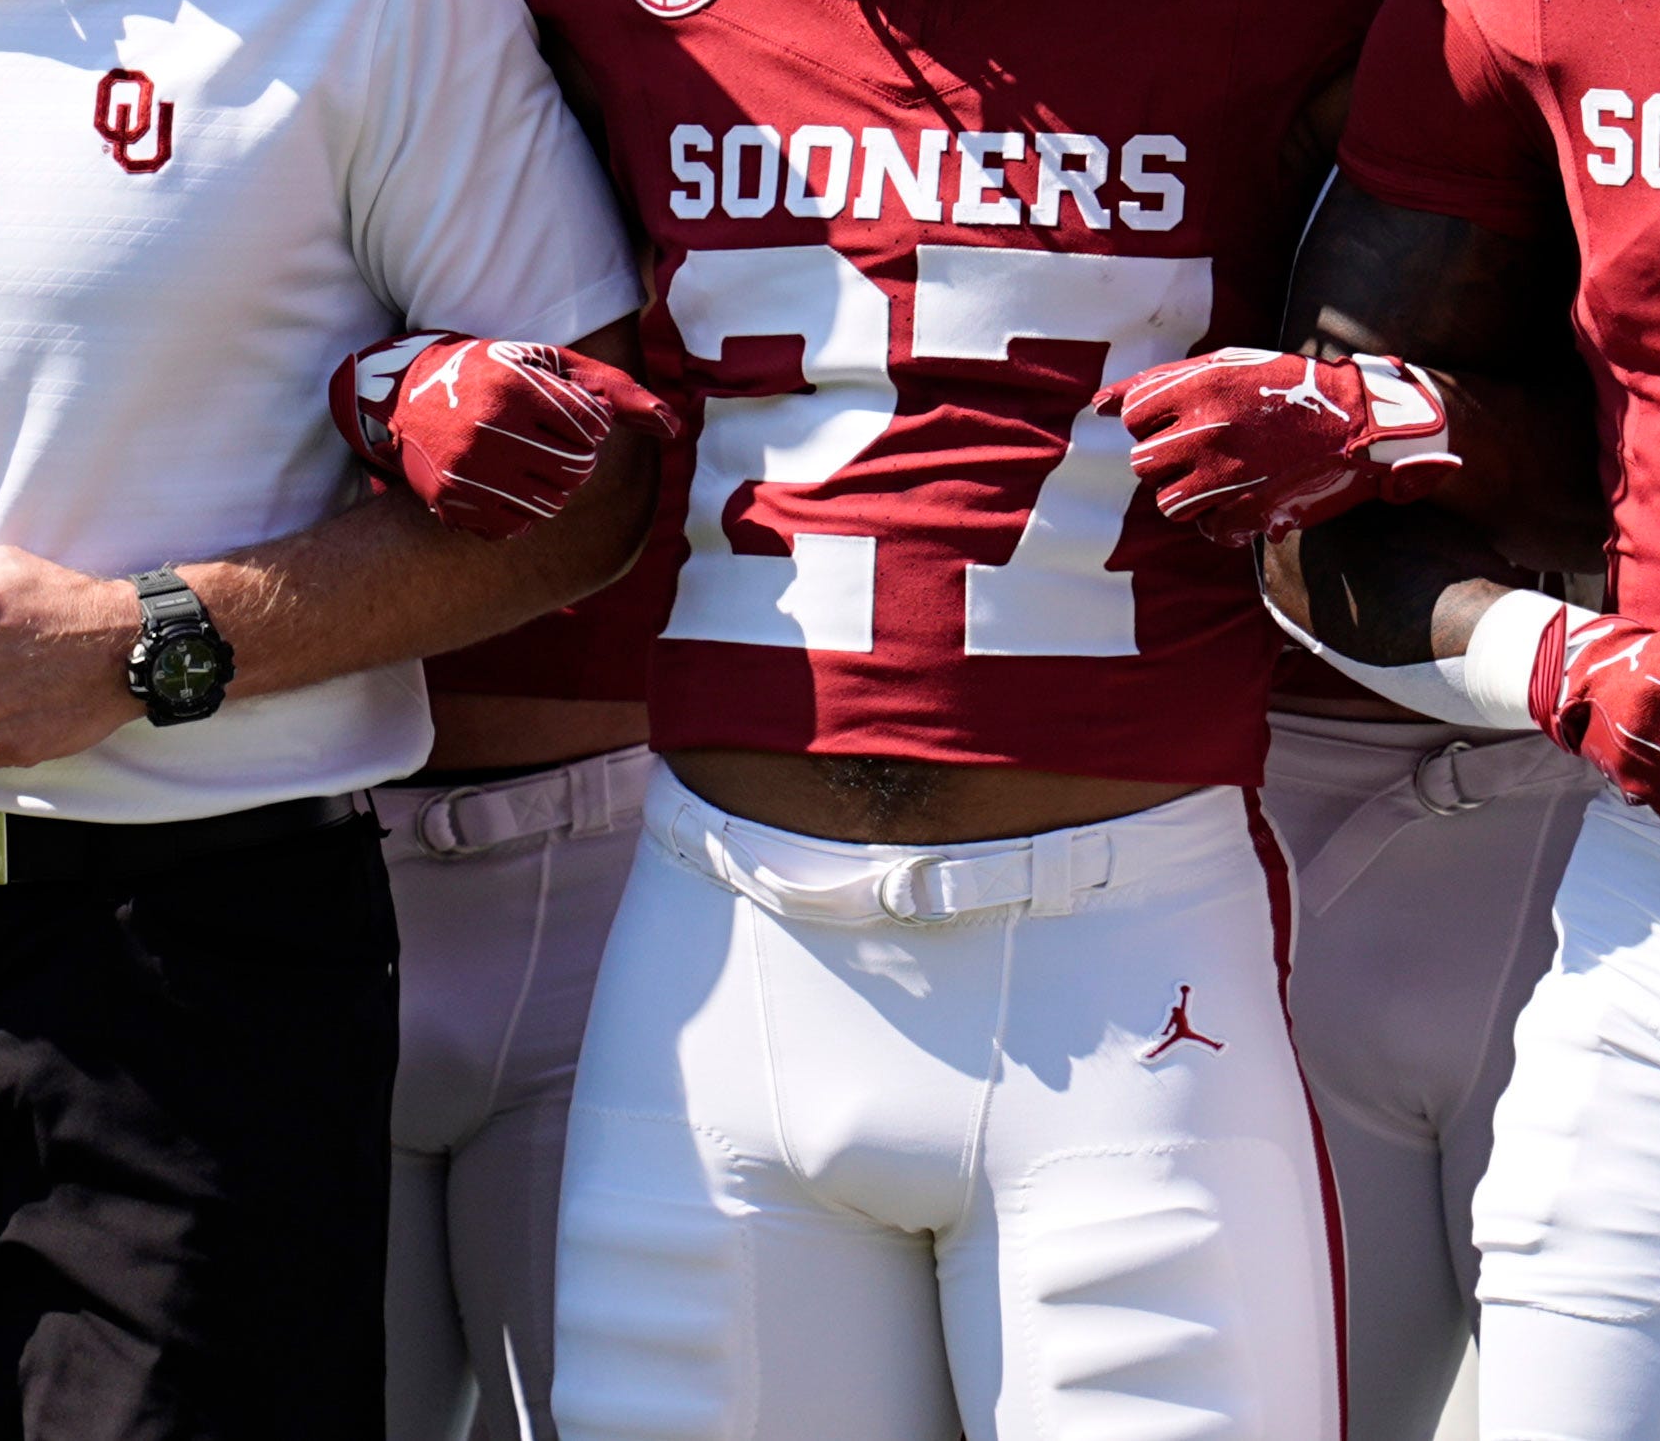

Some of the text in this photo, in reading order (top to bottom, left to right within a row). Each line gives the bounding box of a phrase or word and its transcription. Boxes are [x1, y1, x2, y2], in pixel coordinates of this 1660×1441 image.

[94, 68, 174, 174] OU
[670, 124, 1187, 232] SOONERS
[659, 245, 1214, 657] 27
